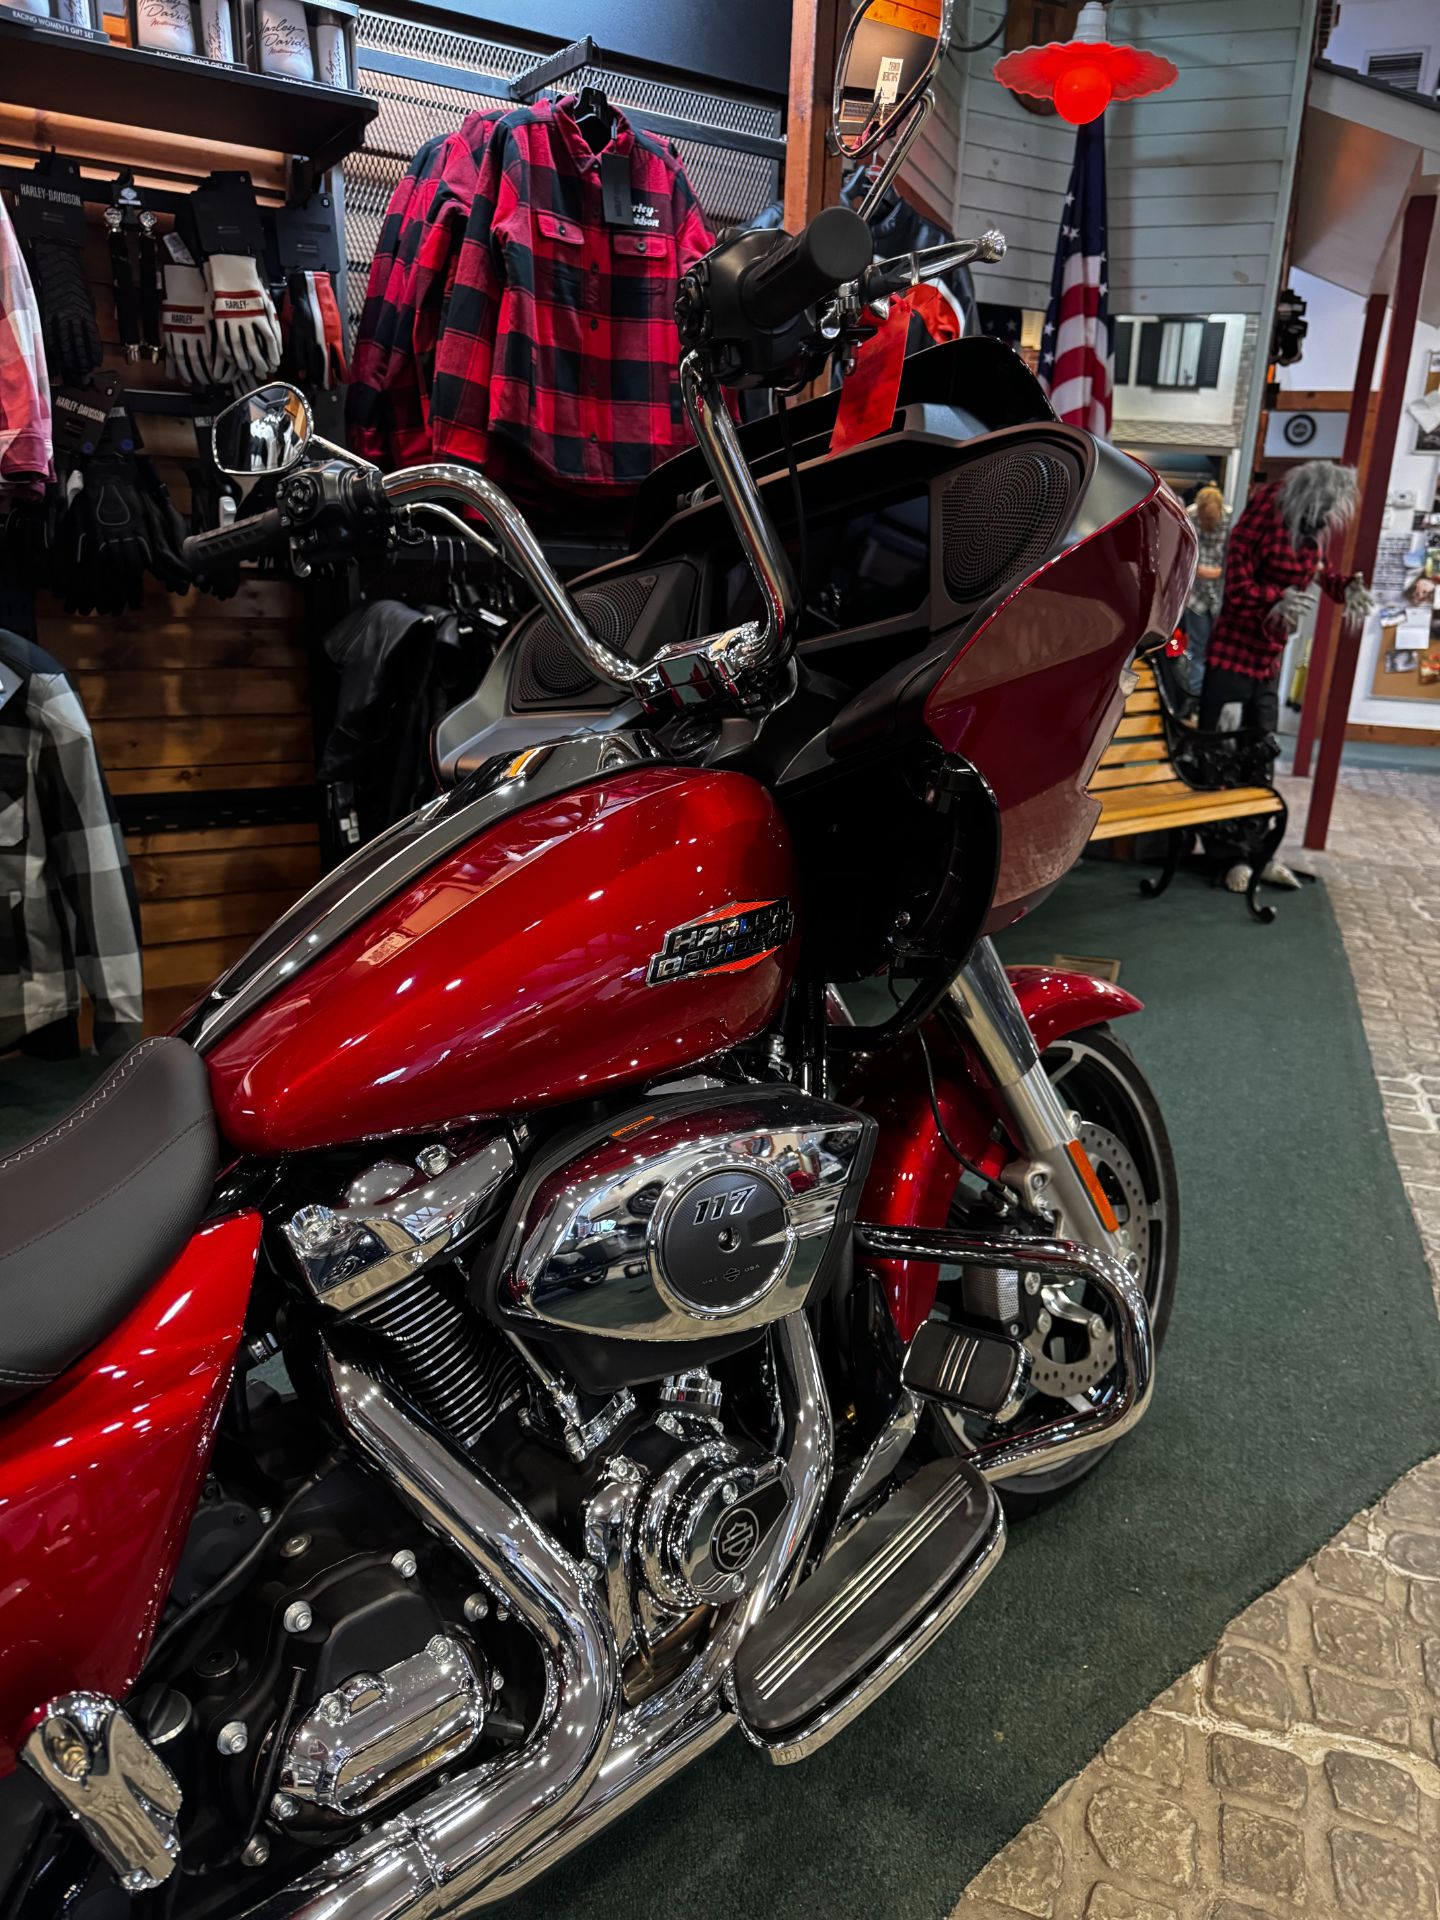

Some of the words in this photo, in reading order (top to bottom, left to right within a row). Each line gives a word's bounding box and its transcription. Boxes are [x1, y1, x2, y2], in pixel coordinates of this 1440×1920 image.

[12, 10, 37, 23] RACING
[38, 17, 70, 33] WOMEN'S
[70, 27, 83, 36] GIFT
[84, 31, 94, 39] SET
[20, 183, 81, 206] HARLEY-DAVIDSON
[55, 396, 107, 424] HARLEY-DAVIDSON
[693, 1184, 758, 1226] 117
